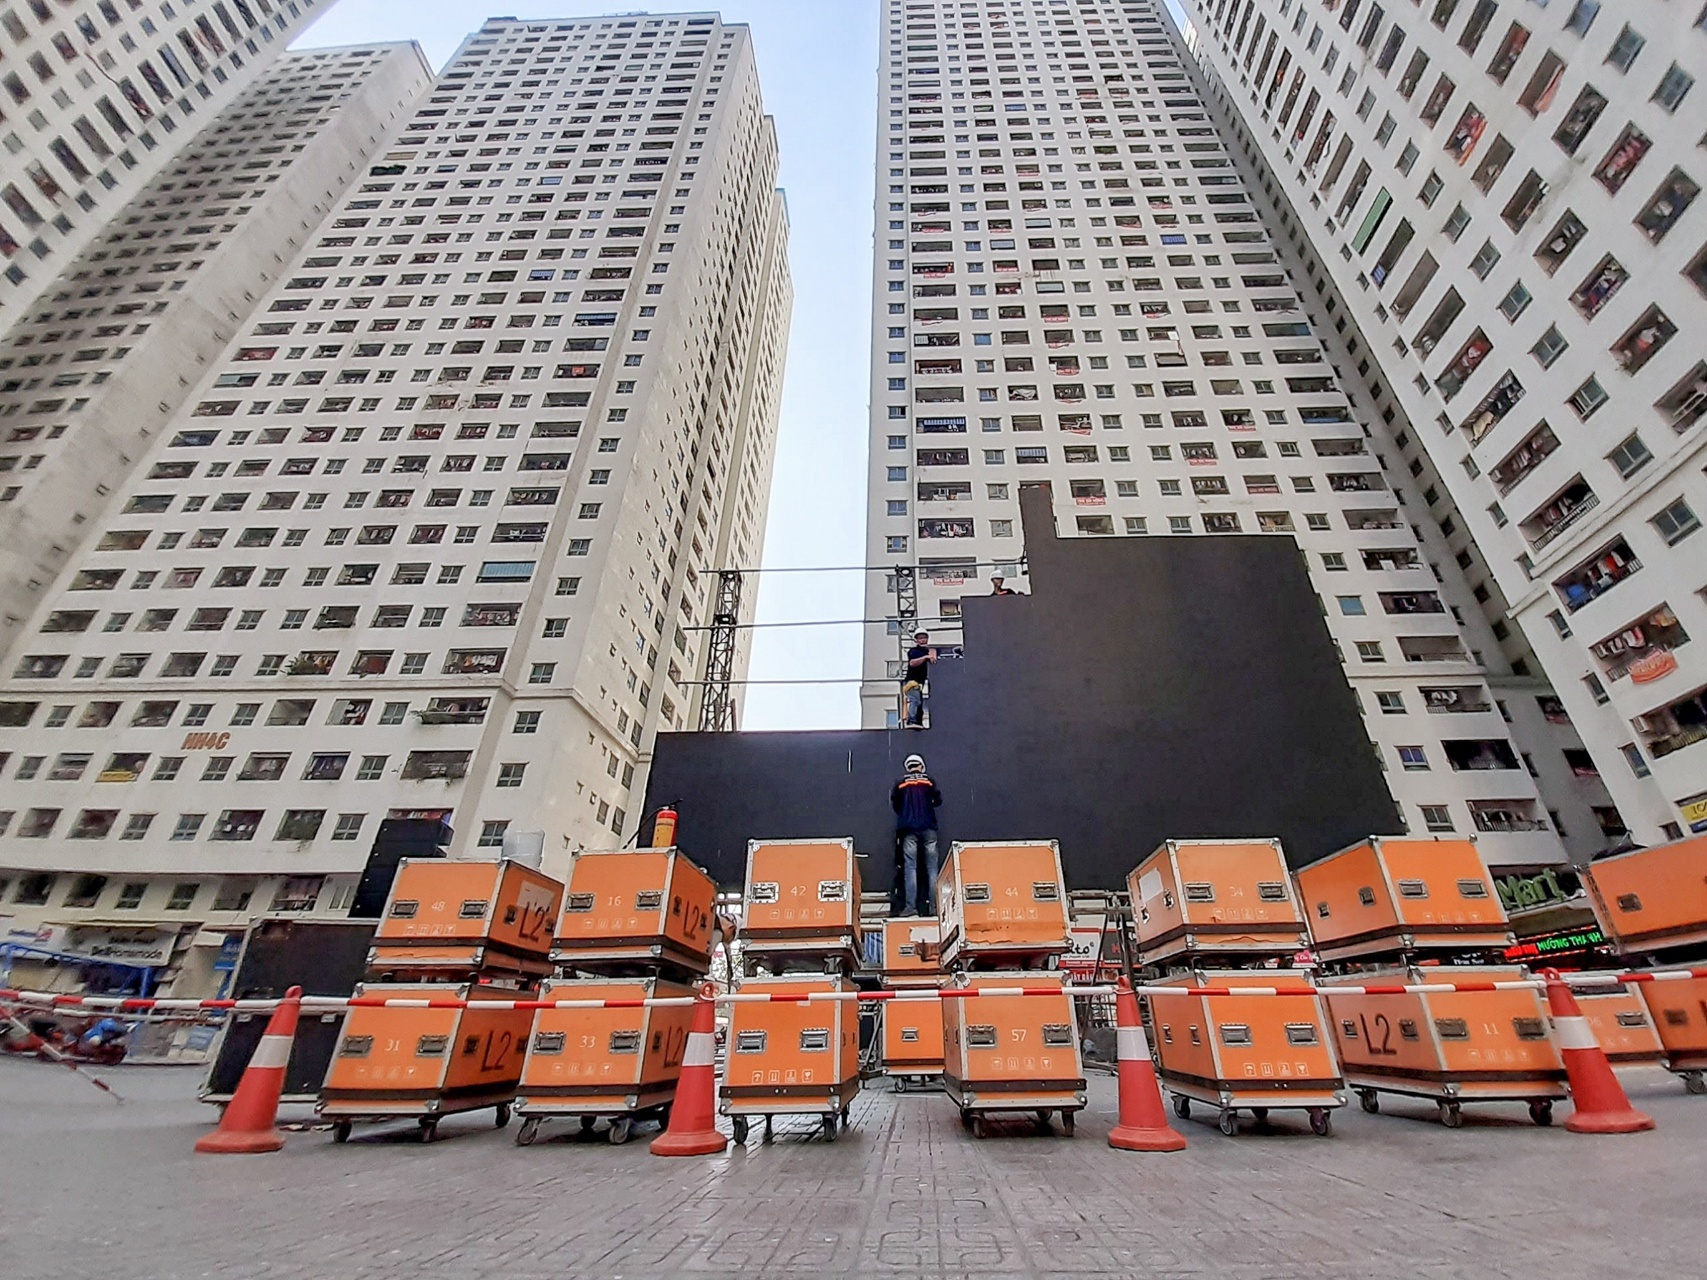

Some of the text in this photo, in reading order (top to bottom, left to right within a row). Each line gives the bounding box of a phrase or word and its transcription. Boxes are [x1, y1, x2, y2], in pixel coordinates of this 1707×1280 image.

[181, 732, 231, 750] NH4C
[790, 885, 807, 896] 42
[1005, 887, 1019, 897] 44
[1495, 867, 1566, 911] Mart
[608, 896, 622, 906] 16
[518, 900, 545, 943] L2
[683, 900, 700, 941] L2
[1011, 1028, 1027, 1041] 57
[1359, 1012, 1398, 1055] L2
[384, 1039, 401, 1051] 31
[578, 1035, 596, 1048] 33
[481, 1029, 512, 1073] L2
